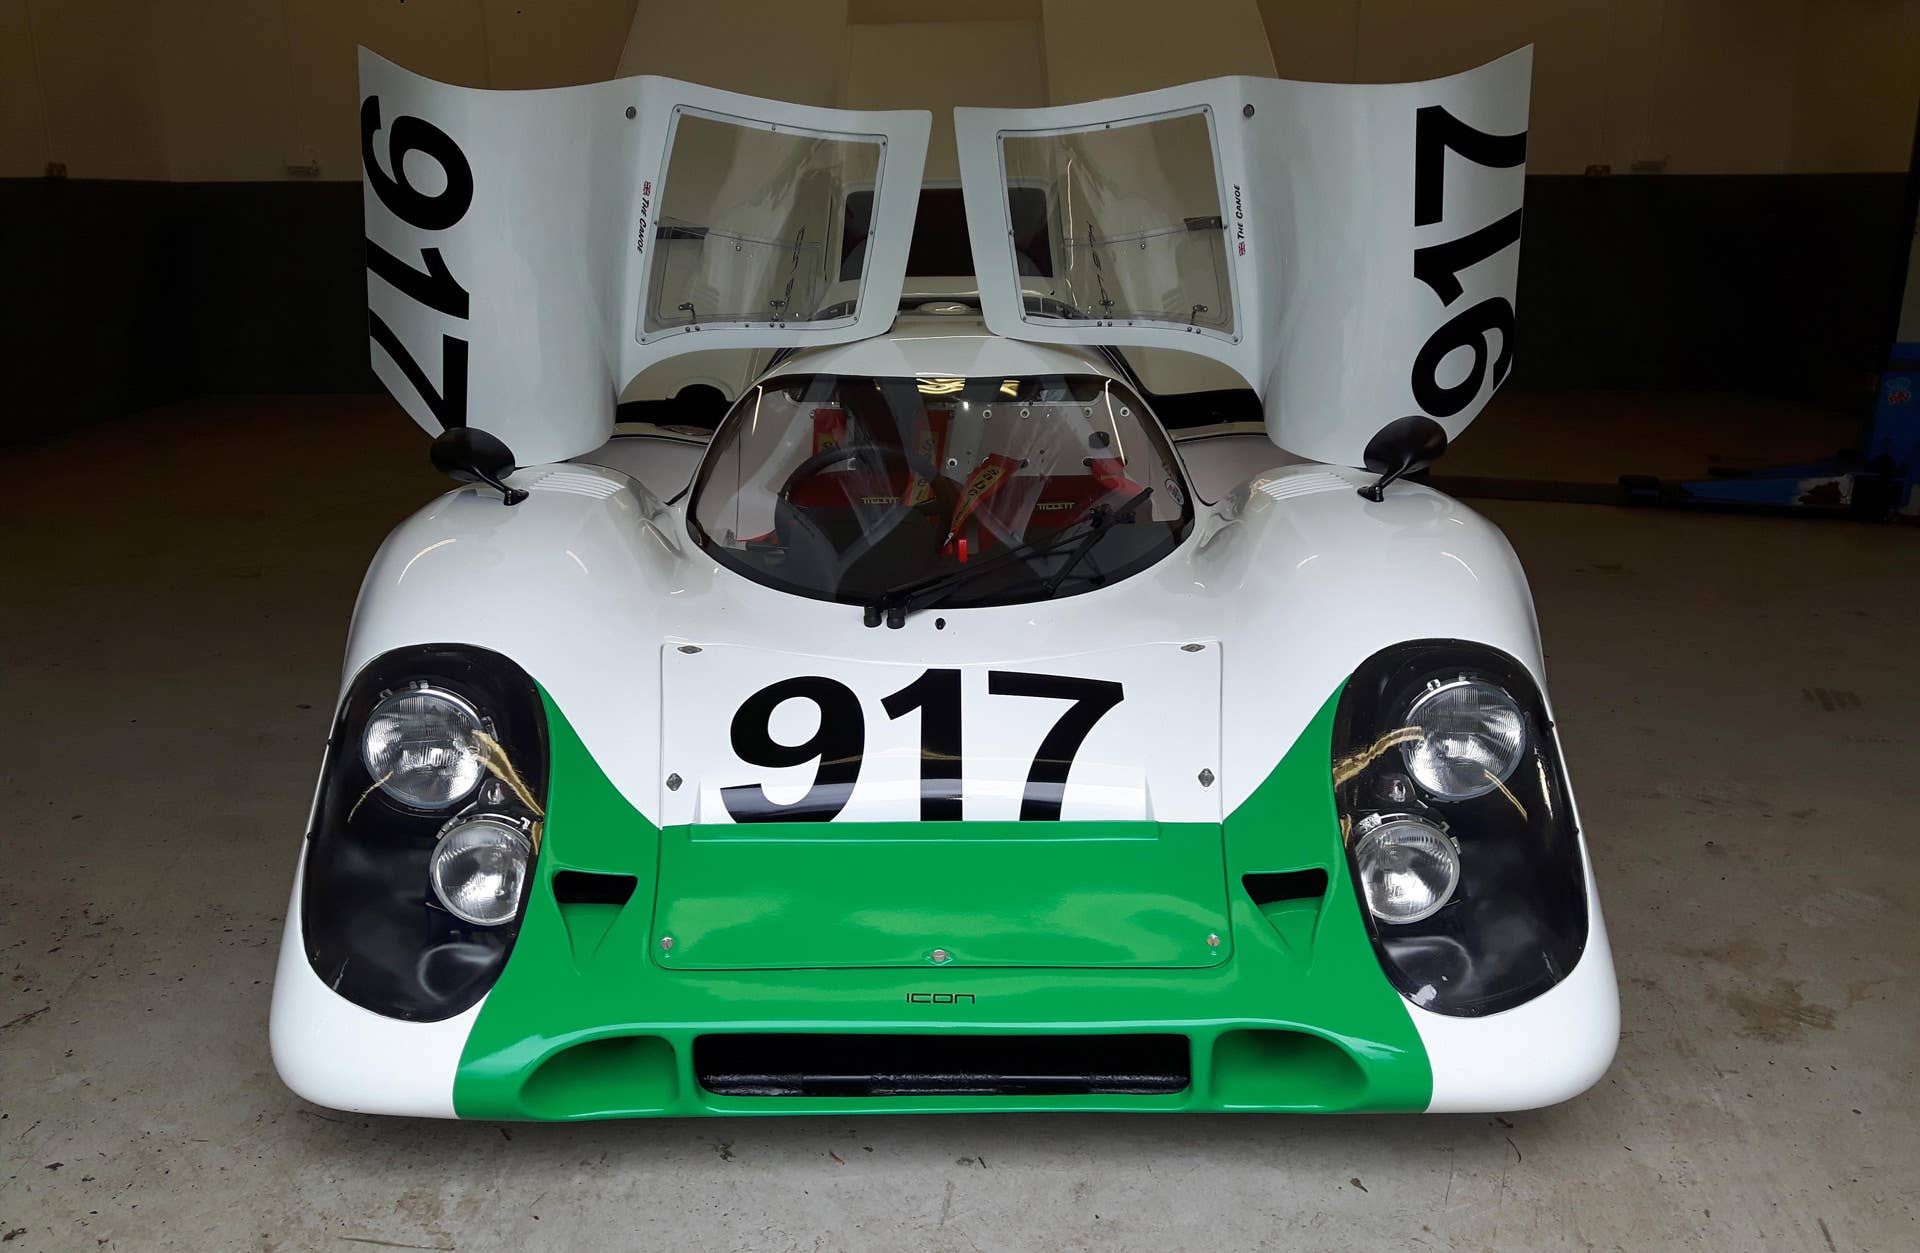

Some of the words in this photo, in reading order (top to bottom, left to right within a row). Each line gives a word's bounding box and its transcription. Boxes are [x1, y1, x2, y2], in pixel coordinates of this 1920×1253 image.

[360, 95, 474, 432] 917
[1410, 105, 1528, 418] 917
[720, 668, 1125, 822] 917
